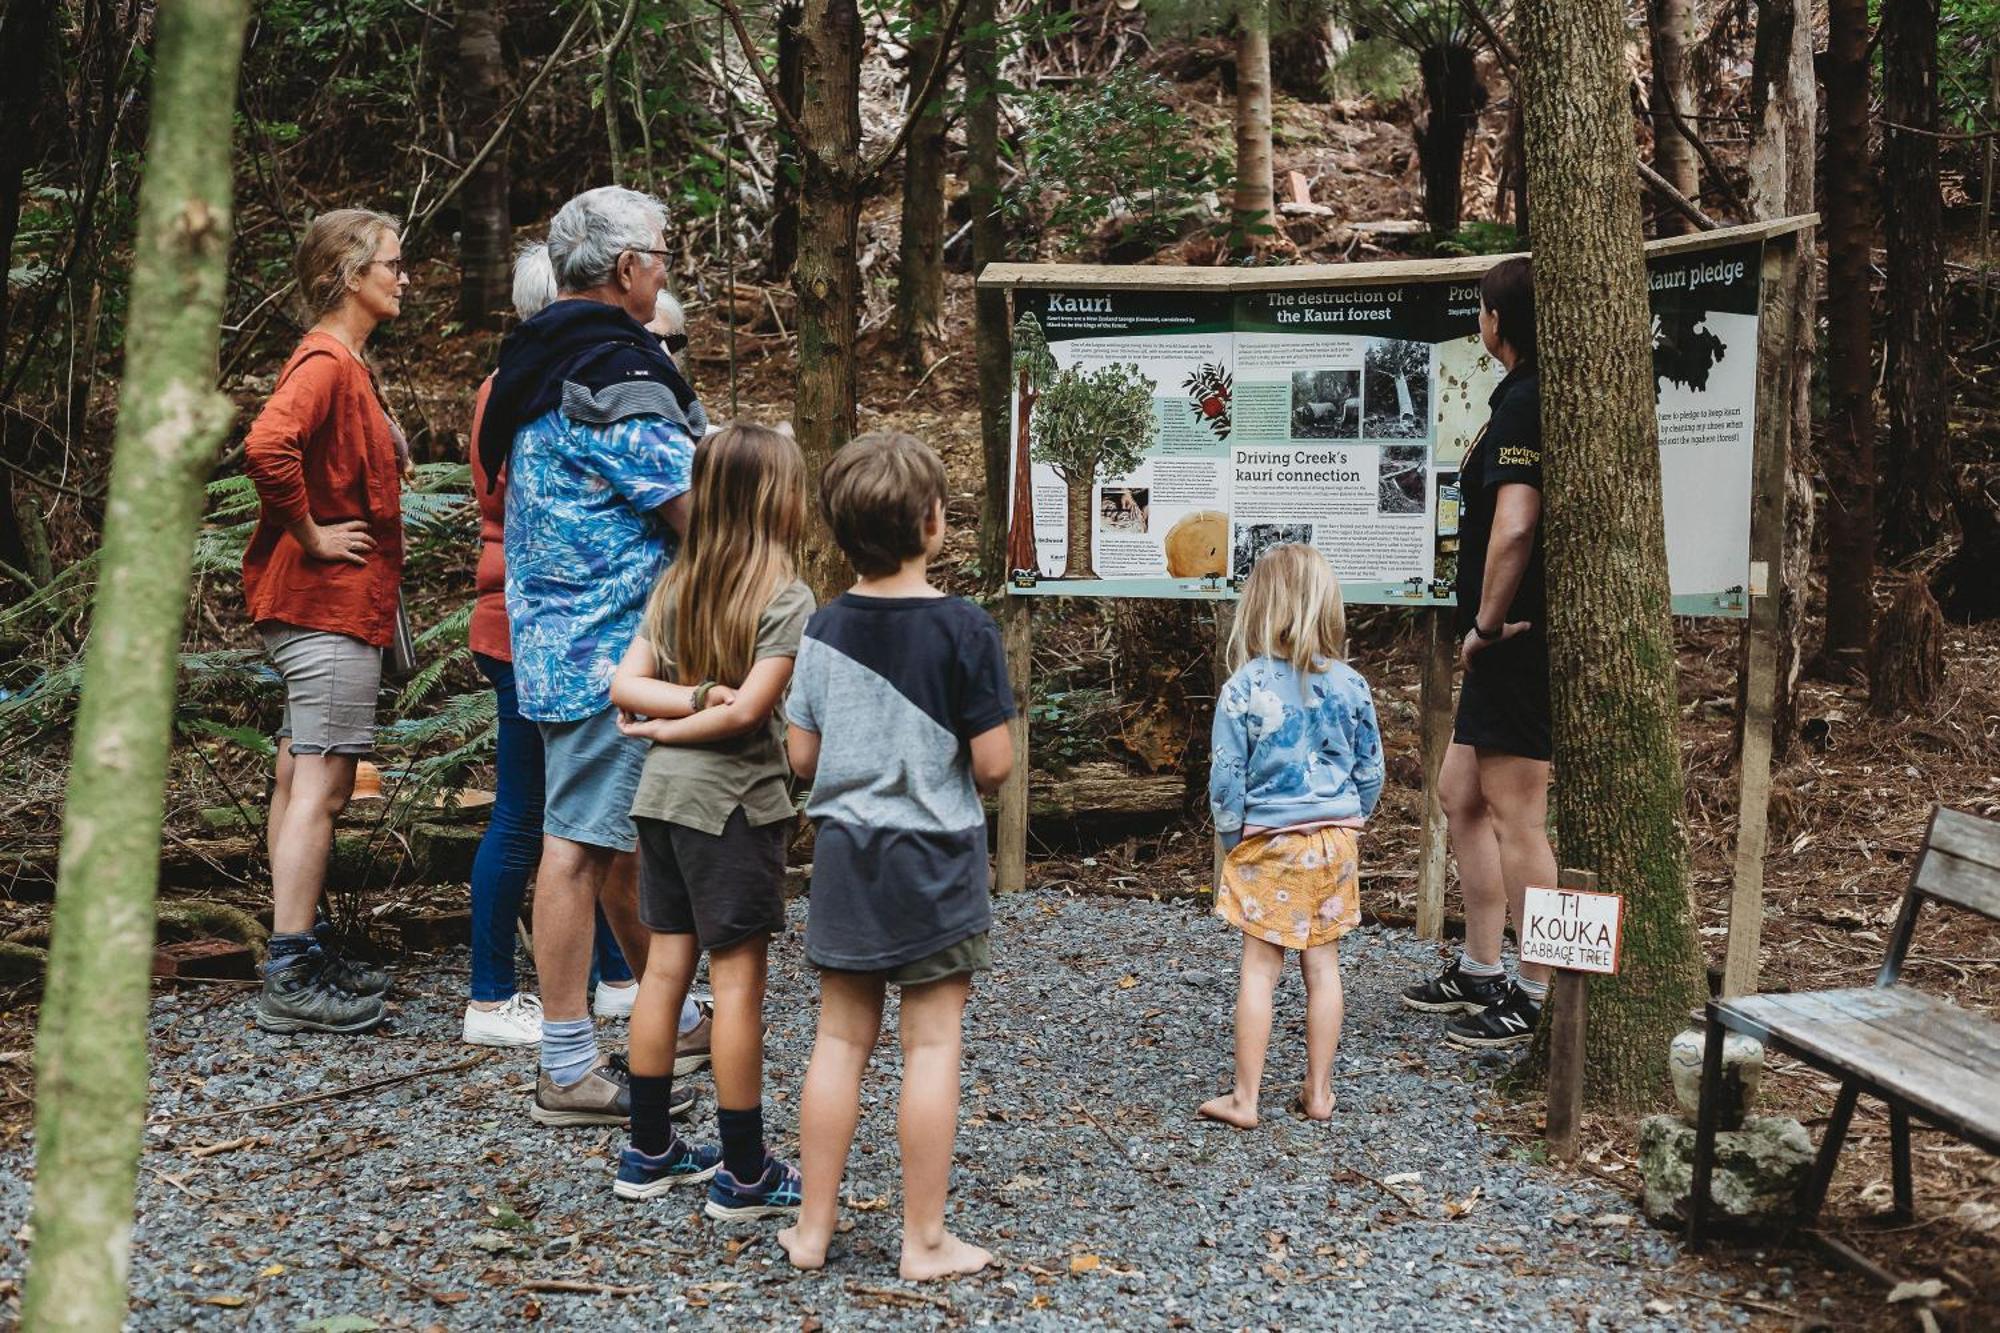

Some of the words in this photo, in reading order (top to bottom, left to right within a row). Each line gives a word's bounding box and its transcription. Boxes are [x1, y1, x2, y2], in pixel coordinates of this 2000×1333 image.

[1689, 260, 1744, 291] pledge
[1267, 292, 1294, 306] The
[1298, 290, 1383, 305] destruction
[1387, 288, 1403, 302] of
[1448, 286, 1480, 301] Prot
[1047, 293, 1113, 313] Kauri
[1277, 309, 1300, 323] the
[1304, 308, 1344, 322] Kauri
[1348, 307, 1391, 321] forest
[1236, 451, 1290, 467] Driving
[1295, 451, 1348, 465] Creek's
[1498, 455, 1532, 466] Creek
[1235, 468, 1273, 481] kauri
[1276, 469, 1361, 482] connection
[1530, 915, 1612, 948] KOUKA
[1522, 940, 1575, 962] CABBAGE
[1578, 948, 1612, 966] TREE
